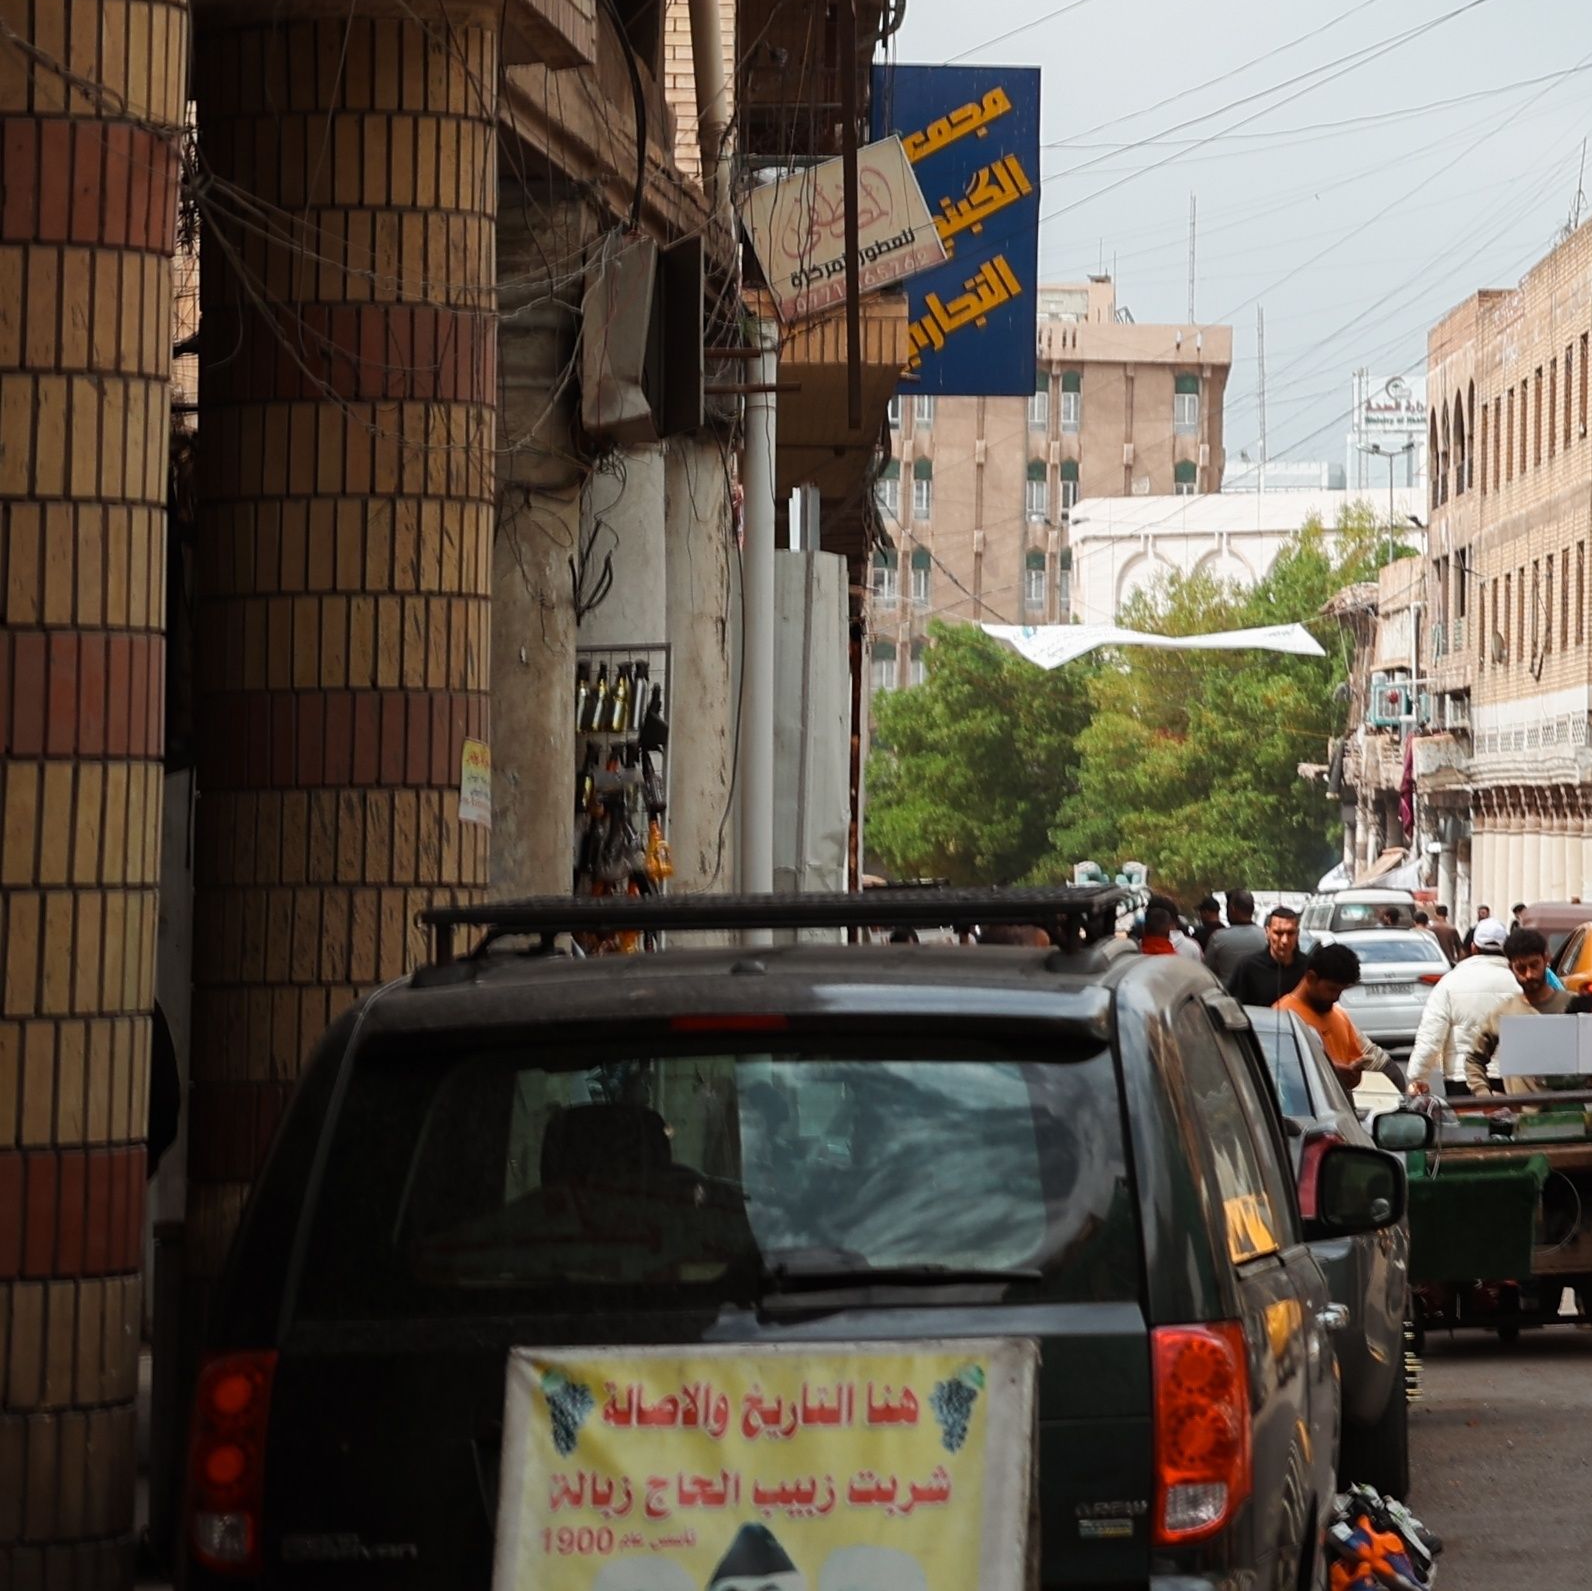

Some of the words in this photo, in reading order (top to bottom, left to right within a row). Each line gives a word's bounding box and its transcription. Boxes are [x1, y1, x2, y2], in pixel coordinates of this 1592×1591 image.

[602, 1380, 731, 1439] والاصالة
[741, 1381, 854, 1439] التاريخ
[866, 1380, 920, 1426] هنا
[548, 1468, 634, 1520] زبالة
[644, 1469, 741, 1522] الحاج
[752, 1470, 836, 1521] زبيب
[846, 1465, 953, 1521] شربت
[540, 1526, 614, 1555] 1900
